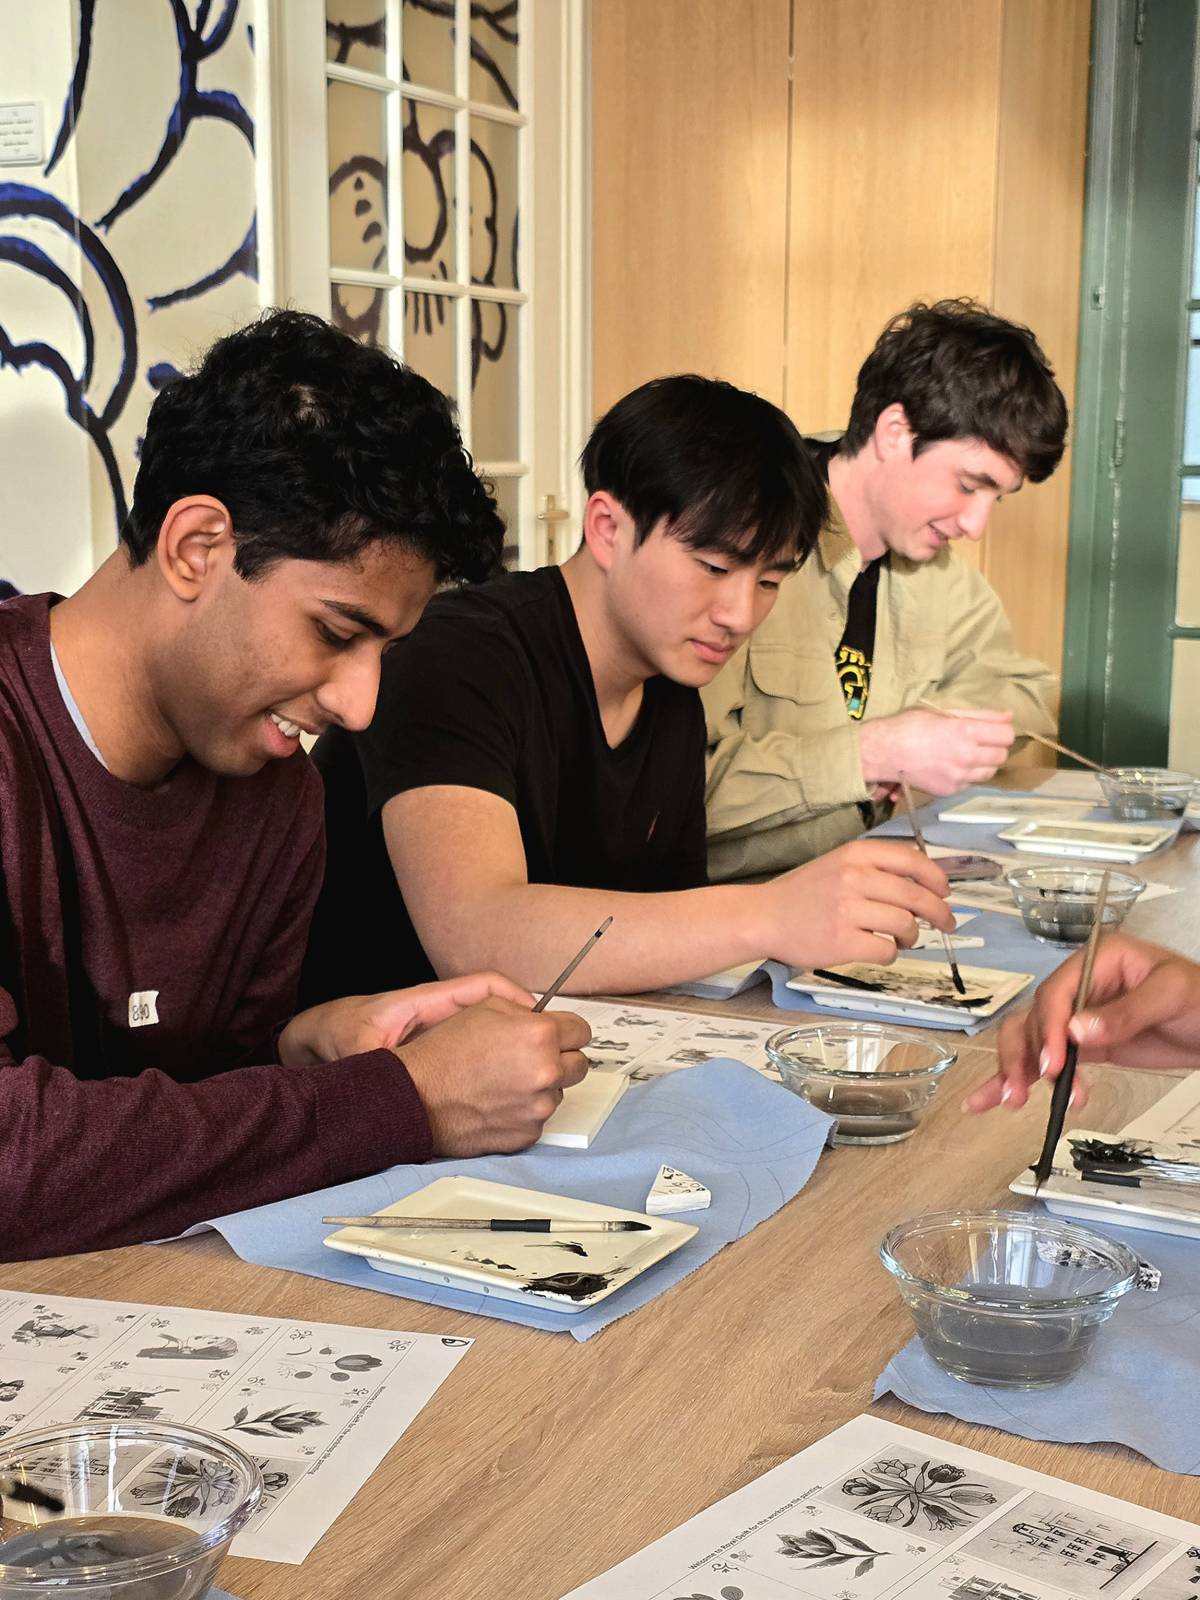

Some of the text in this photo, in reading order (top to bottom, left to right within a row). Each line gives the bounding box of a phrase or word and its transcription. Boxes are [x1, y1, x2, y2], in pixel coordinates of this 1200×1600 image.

[688, 1552, 716, 1570] Welcome
[720, 1539, 737, 1551] Royal
[735, 1530, 751, 1541] Delft
[768, 1503, 793, 1520] workshop
